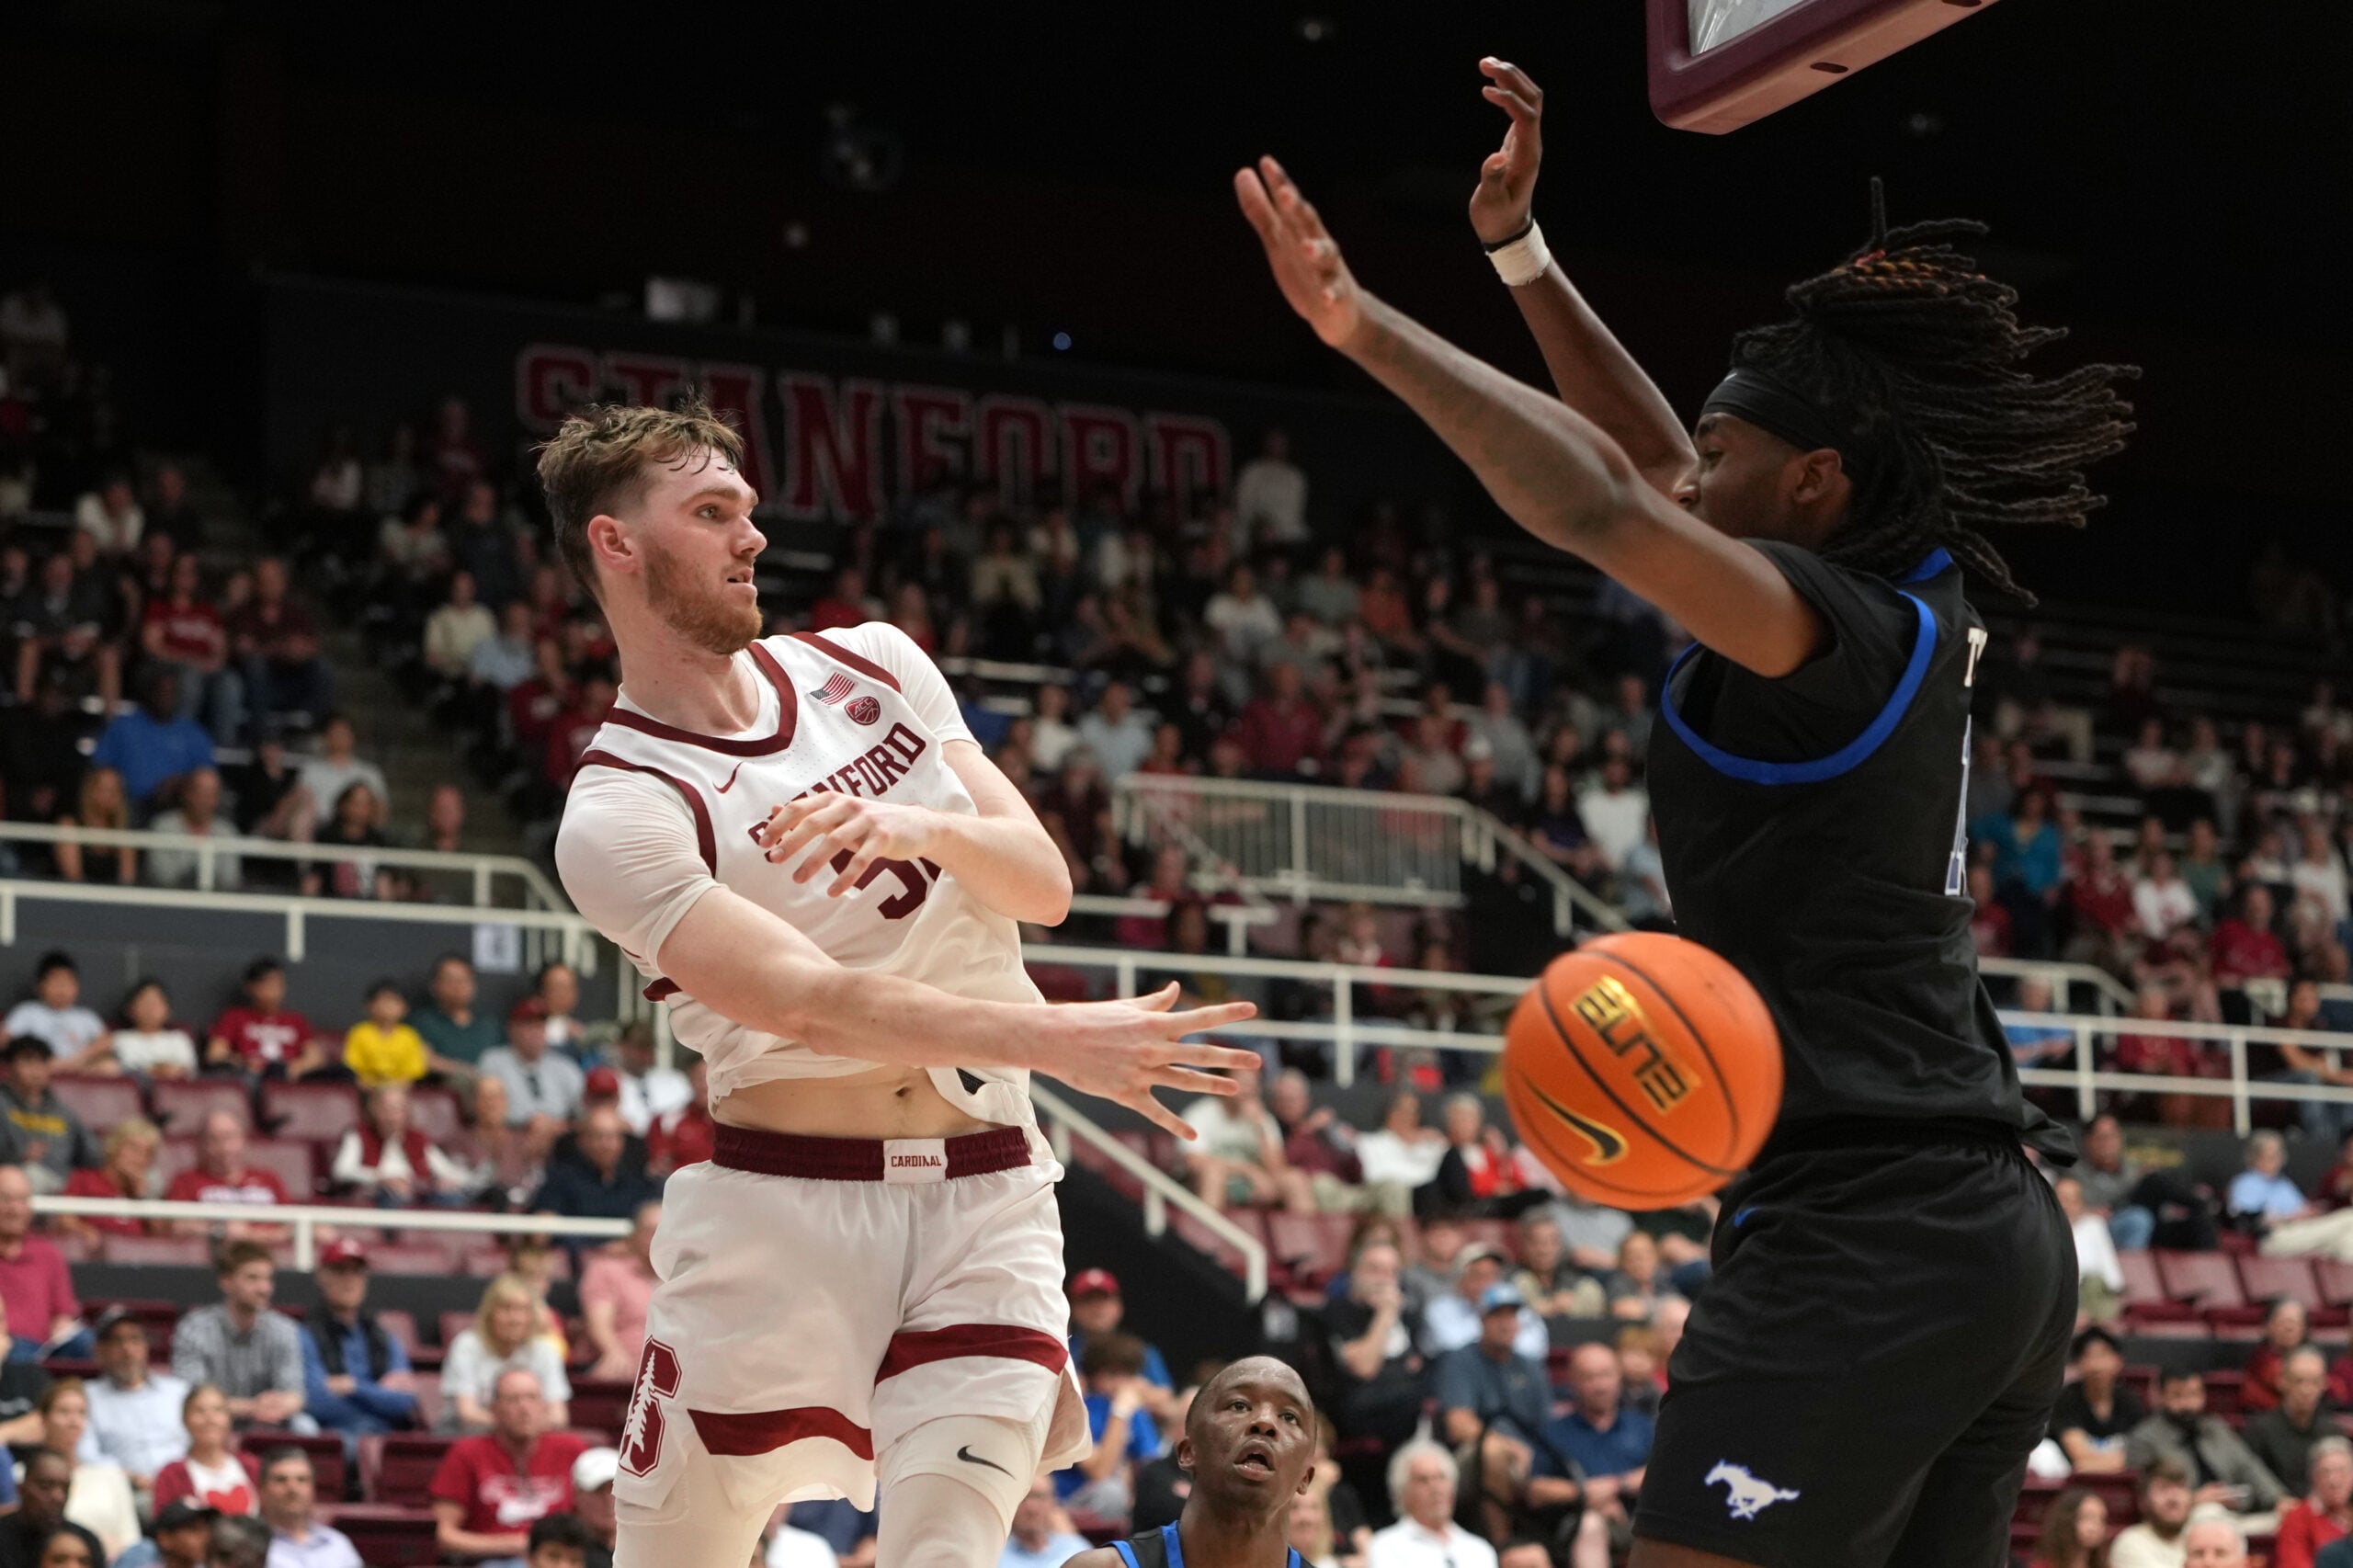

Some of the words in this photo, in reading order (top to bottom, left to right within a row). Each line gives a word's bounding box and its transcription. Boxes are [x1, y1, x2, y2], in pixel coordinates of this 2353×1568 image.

[854, 698, 873, 715] ACC
[1573, 981, 1691, 1111] ELITE
[891, 1155, 942, 1167] CARDINAL
